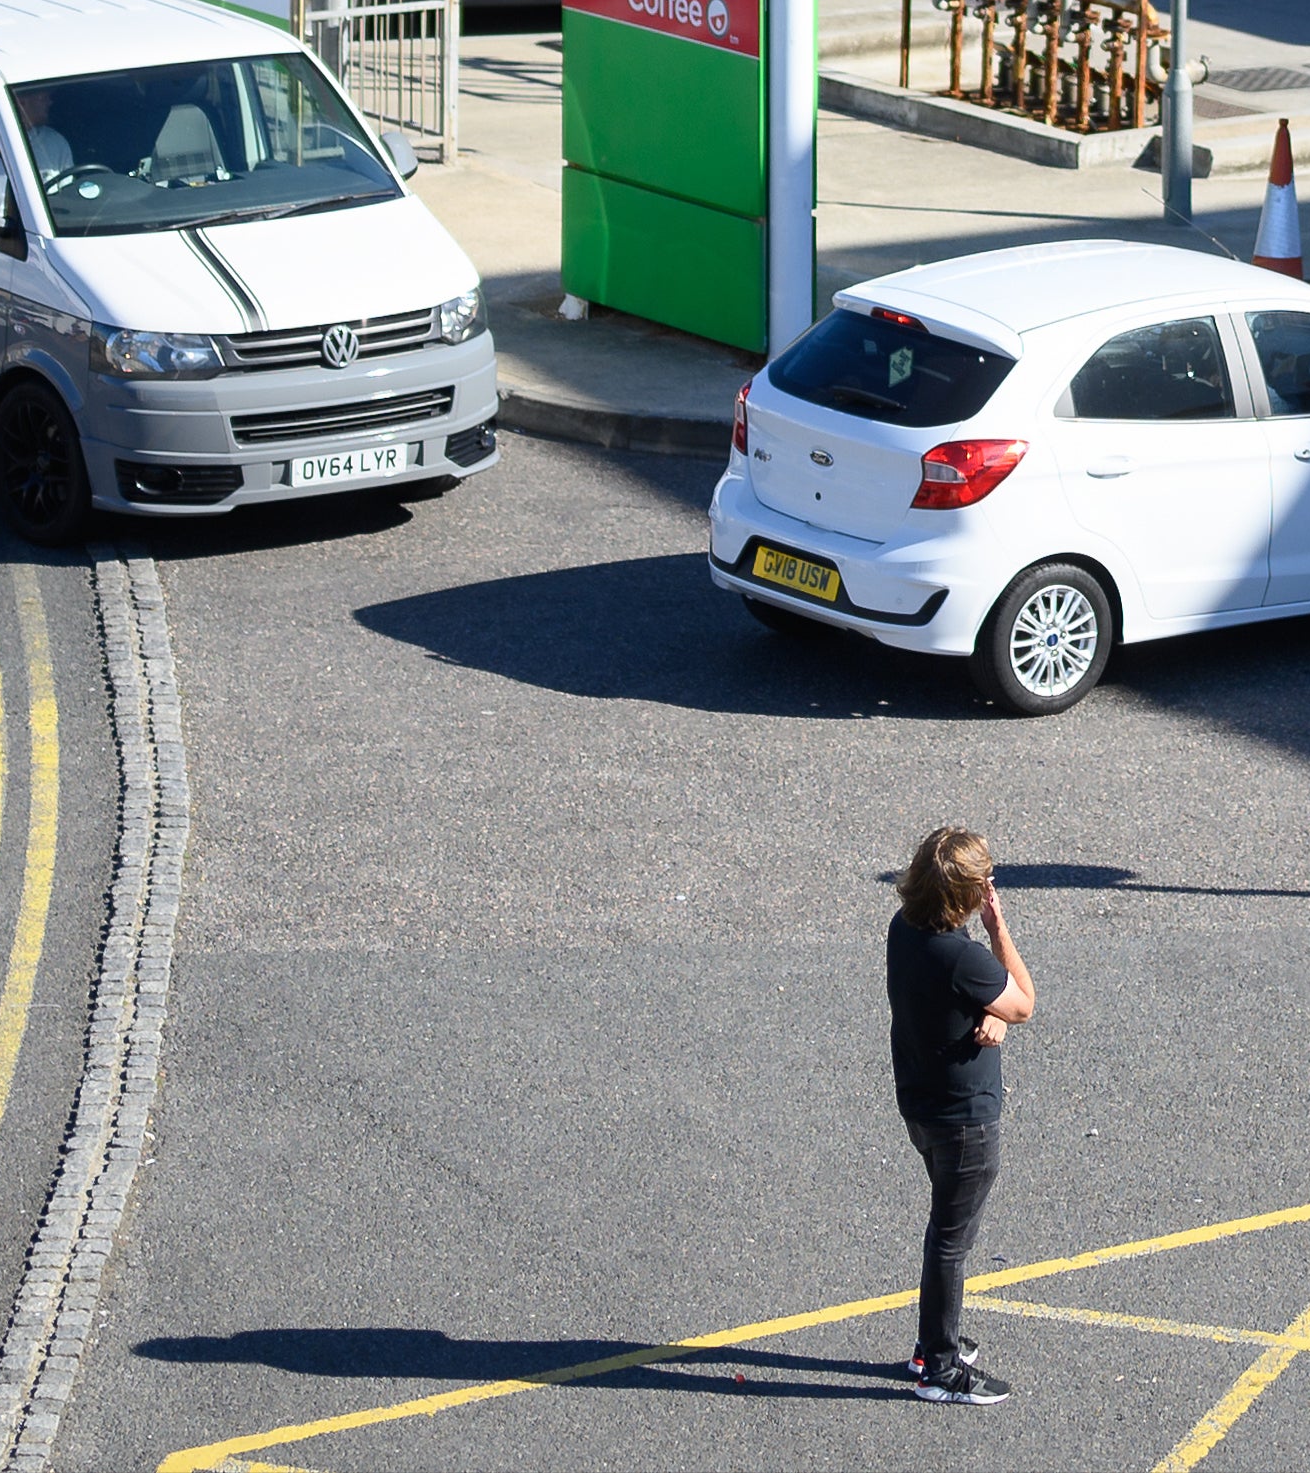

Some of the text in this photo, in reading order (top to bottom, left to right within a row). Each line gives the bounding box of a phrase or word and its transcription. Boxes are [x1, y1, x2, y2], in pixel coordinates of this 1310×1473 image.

[302, 448, 397, 480] OV64 LYR
[763, 551, 832, 593] GV18 USW
